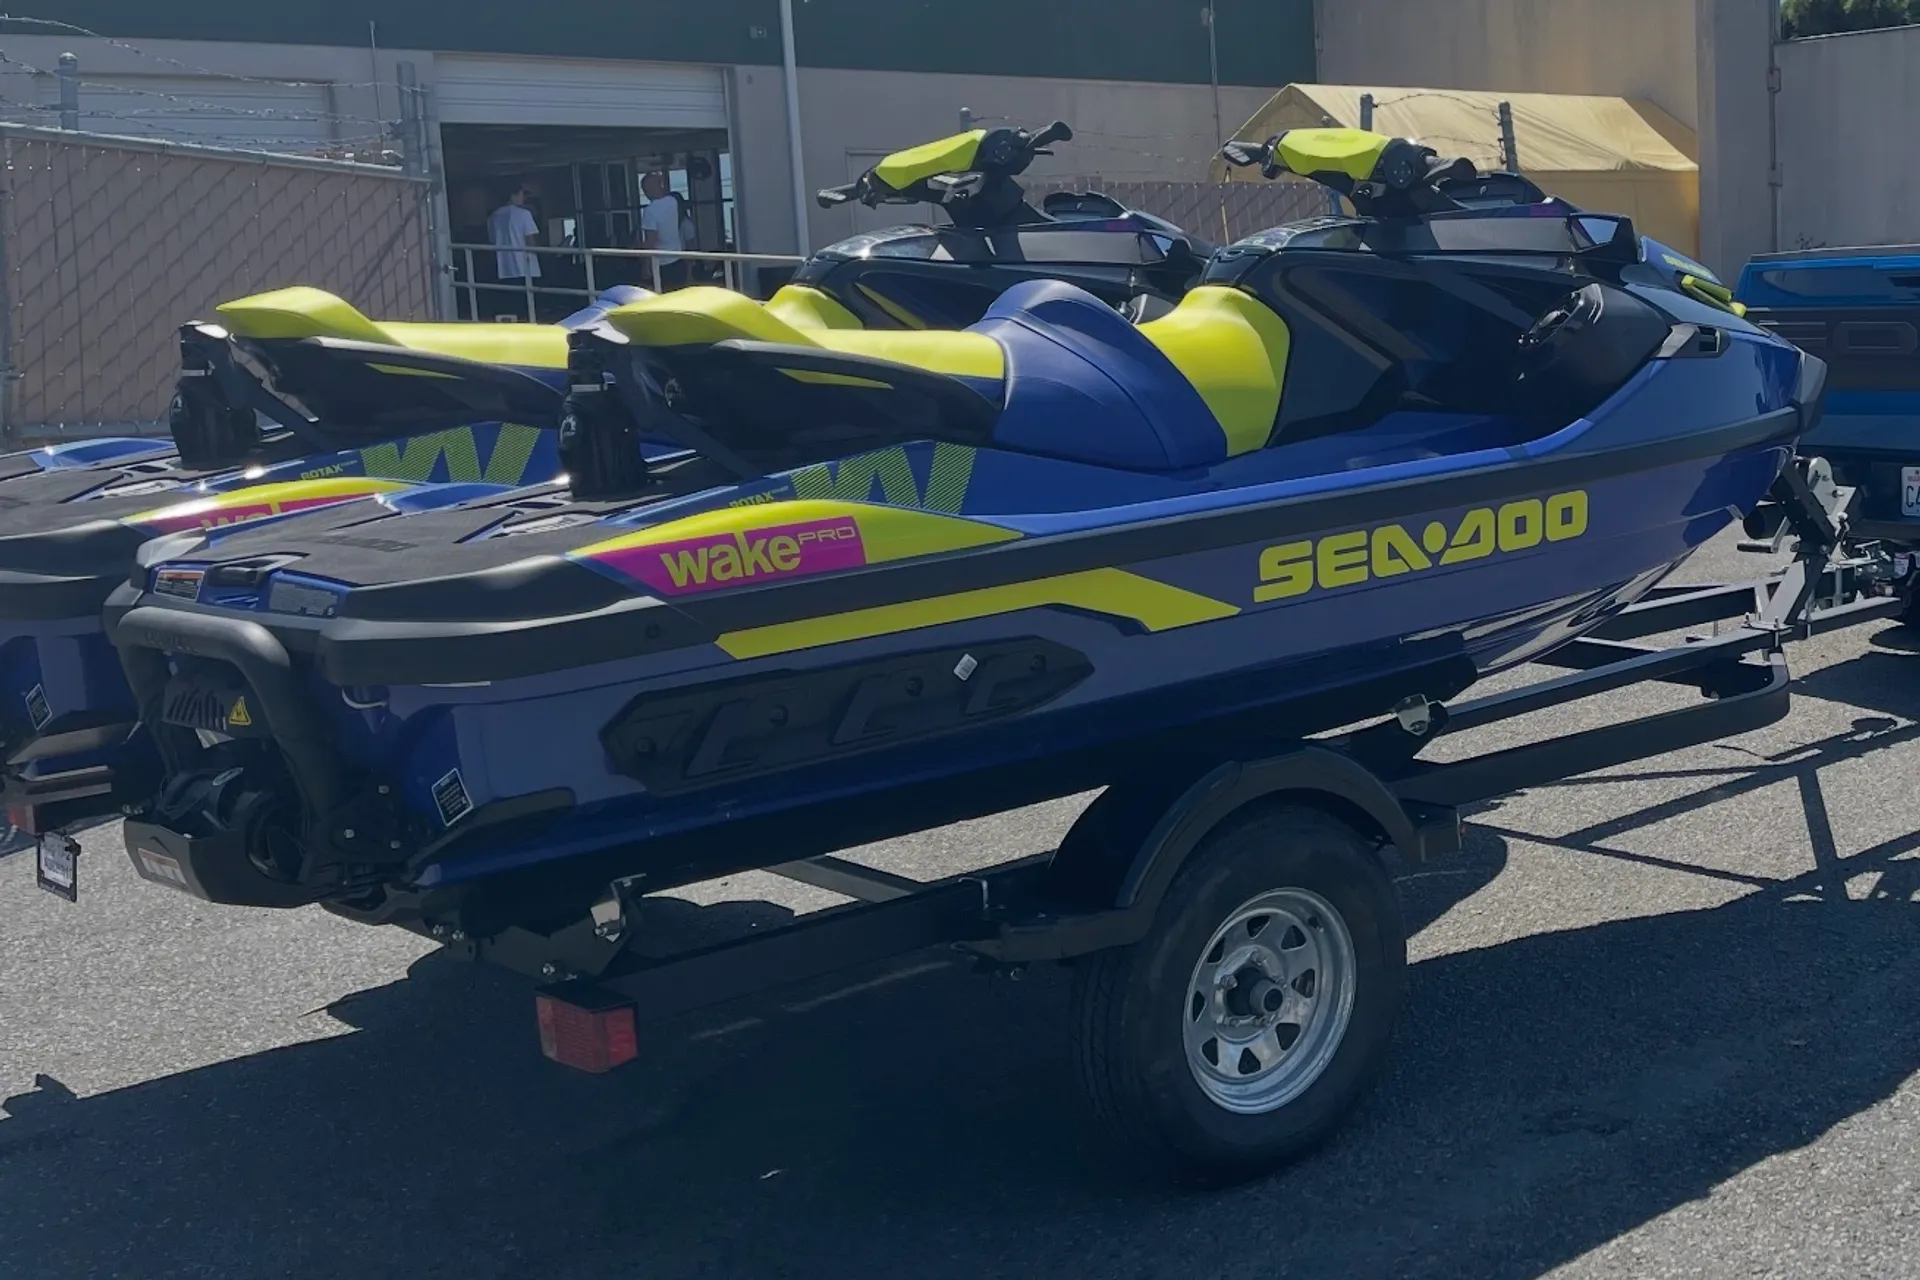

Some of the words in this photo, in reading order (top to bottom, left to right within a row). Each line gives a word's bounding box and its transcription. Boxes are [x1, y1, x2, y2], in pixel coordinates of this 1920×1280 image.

[300, 463, 343, 480] ROTAX
[659, 531, 801, 588] wake
[798, 526, 855, 545] PRO
